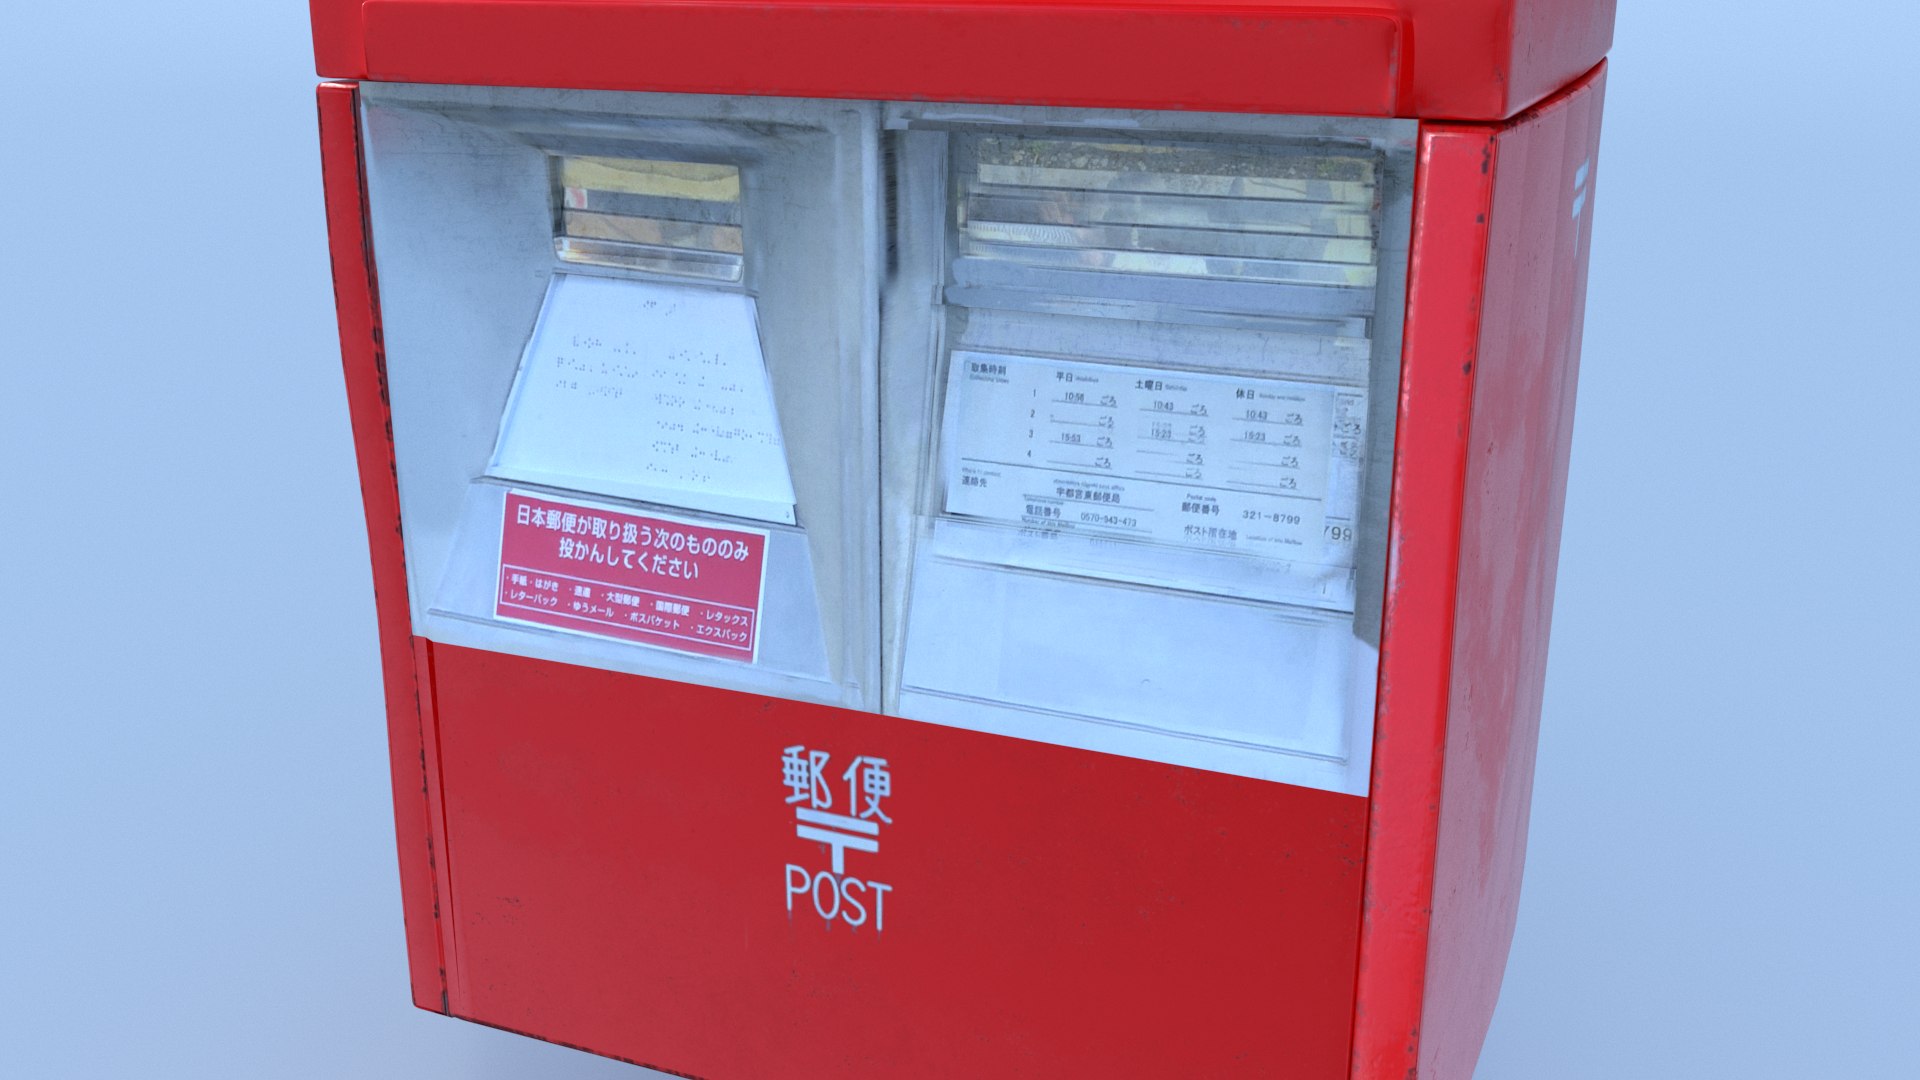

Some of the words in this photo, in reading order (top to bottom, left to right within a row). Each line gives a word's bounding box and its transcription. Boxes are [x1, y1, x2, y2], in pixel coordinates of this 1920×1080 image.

[1056, 371, 1073, 382] 平日
[1134, 379, 1163, 391] 土曜日
[1236, 388, 1255, 400] 休日
[1025, 504, 1062, 519] 電話番号
[1181, 502, 1220, 516] 郵便番号
[1242, 510, 1301, 525] 321-8799
[516, 503, 749, 563] 日本郵便が取り扱う次のもののみ
[558, 536, 700, 580] 投かんしてください
[781, 745, 893, 825] 郵便
[785, 863, 893, 931] POST
